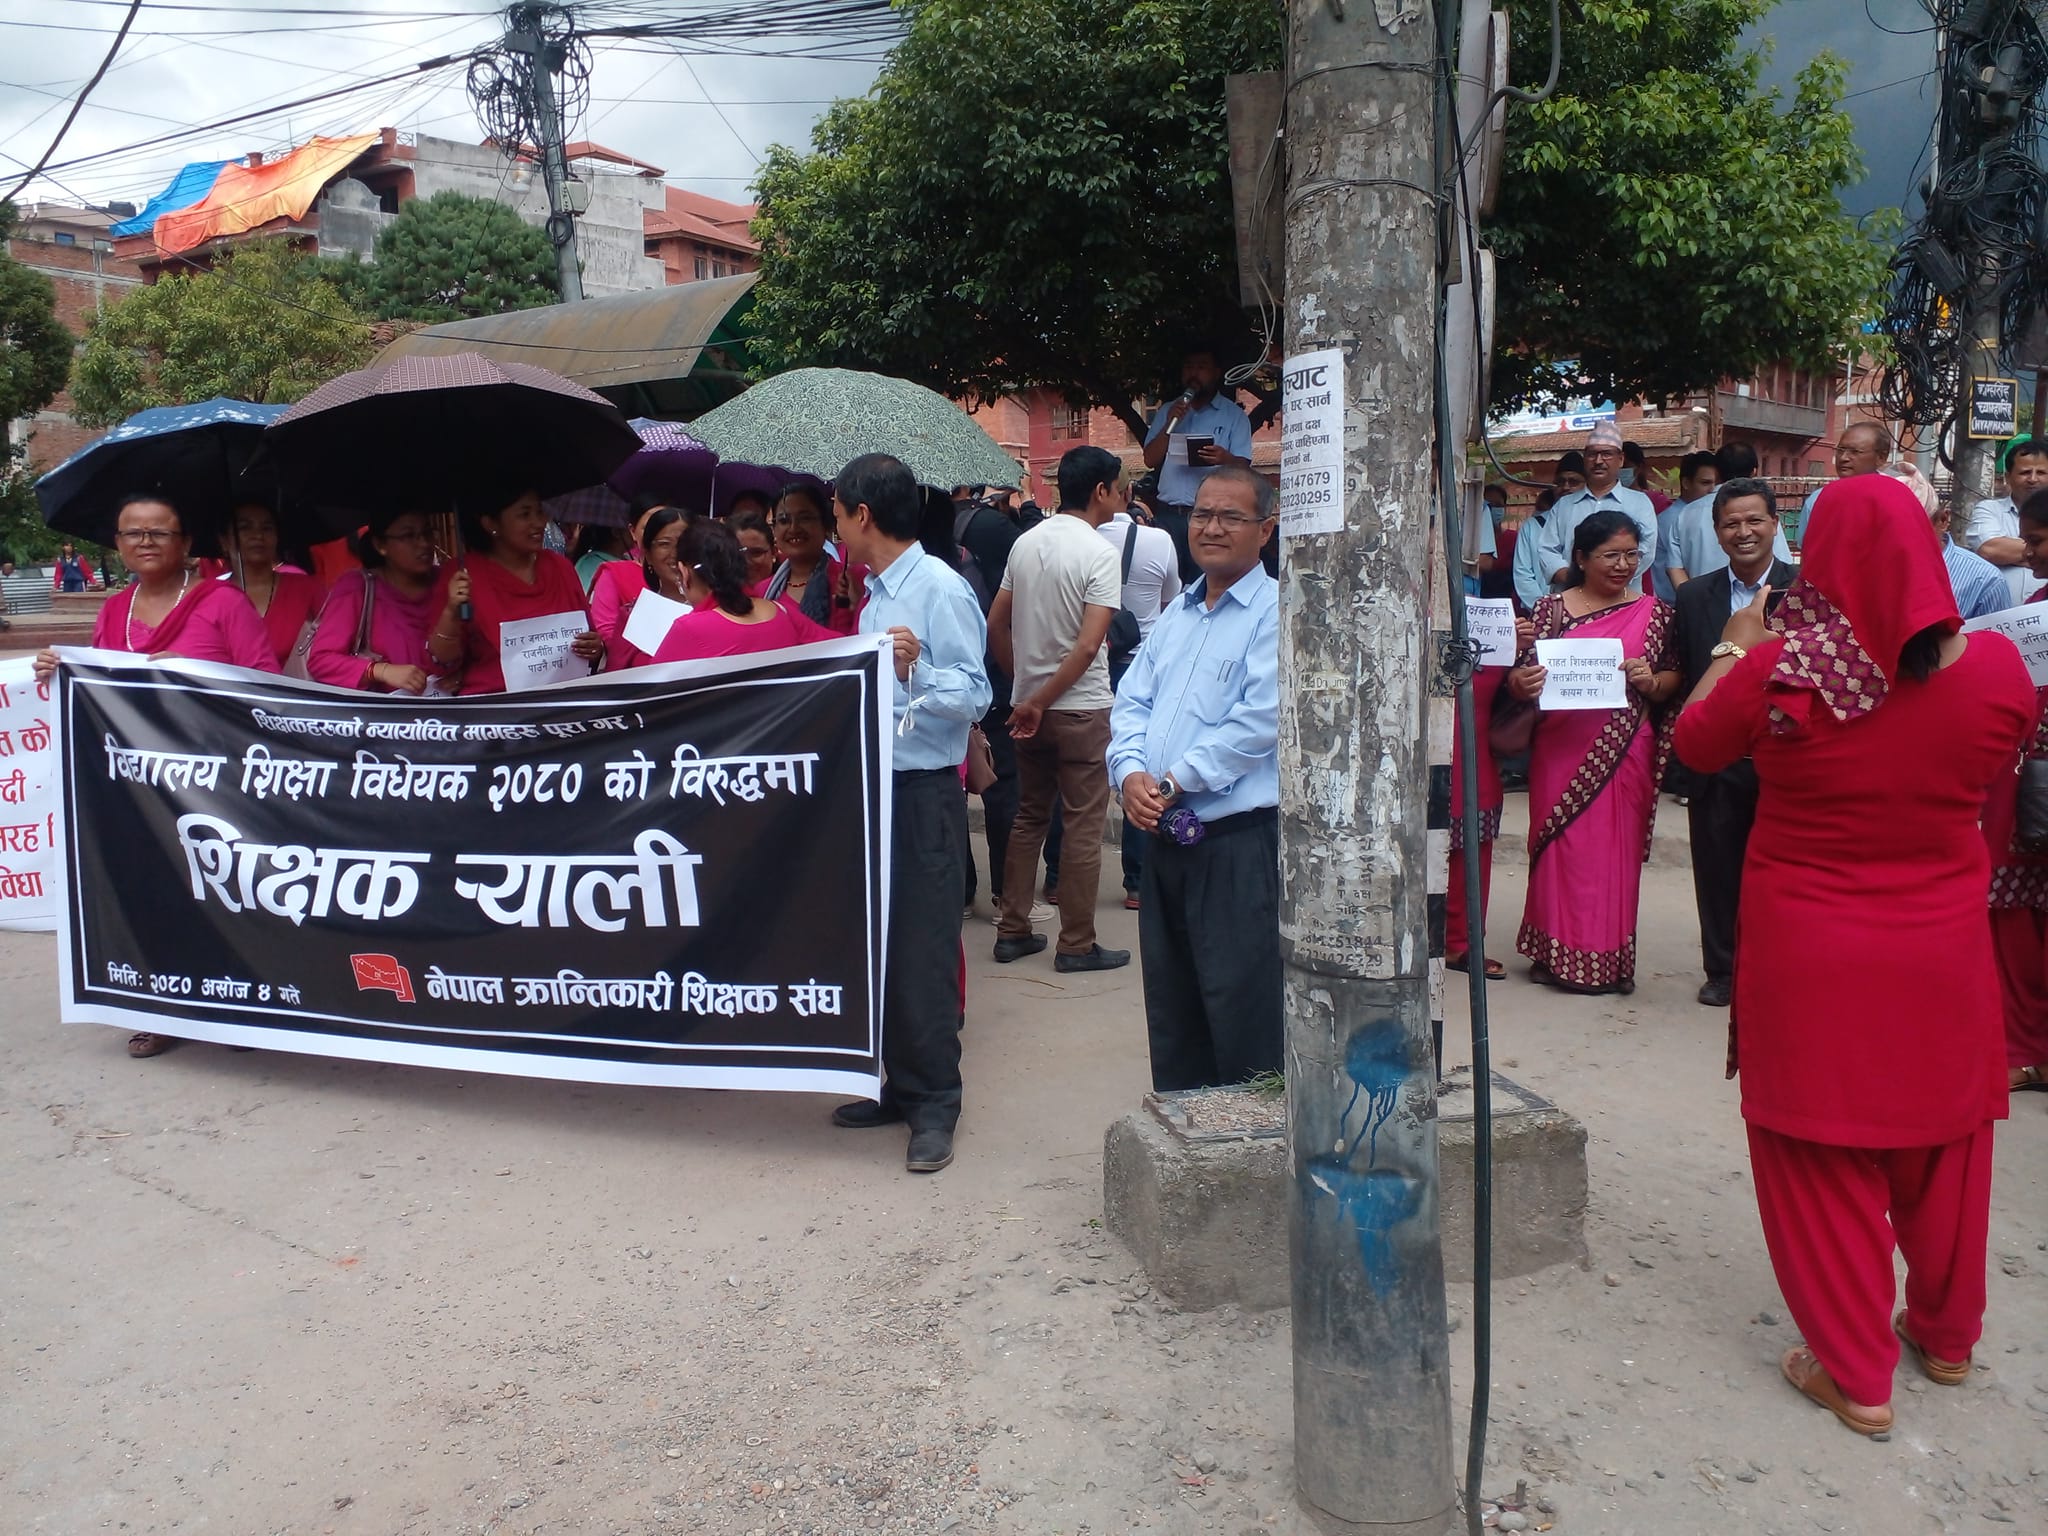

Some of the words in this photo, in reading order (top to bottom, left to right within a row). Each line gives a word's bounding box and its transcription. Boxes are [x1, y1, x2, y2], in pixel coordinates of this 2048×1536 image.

[2016, 615, 2040, 629] सम्म
[365, 718, 459, 741] न्यायोचित
[542, 721, 587, 738] पूरा
[588, 715, 629, 732] गर
[104, 732, 228, 793] विद्यालय
[350, 749, 477, 802] विधेयक
[488, 763, 582, 813] २०८०
[604, 749, 656, 801] को
[669, 743, 820, 806] विरुद्धमा
[176, 813, 431, 927] शिक्षक
[149, 974, 193, 995] २०८०
[201, 975, 251, 1000] असोज
[257, 984, 271, 1002] ४
[278, 984, 301, 1005] गते
[424, 965, 505, 1005] नेपाल
[511, 968, 675, 1013] क्रान्तिकारी
[681, 971, 779, 1018] शिक्षक
[787, 977, 843, 1017] संघ
